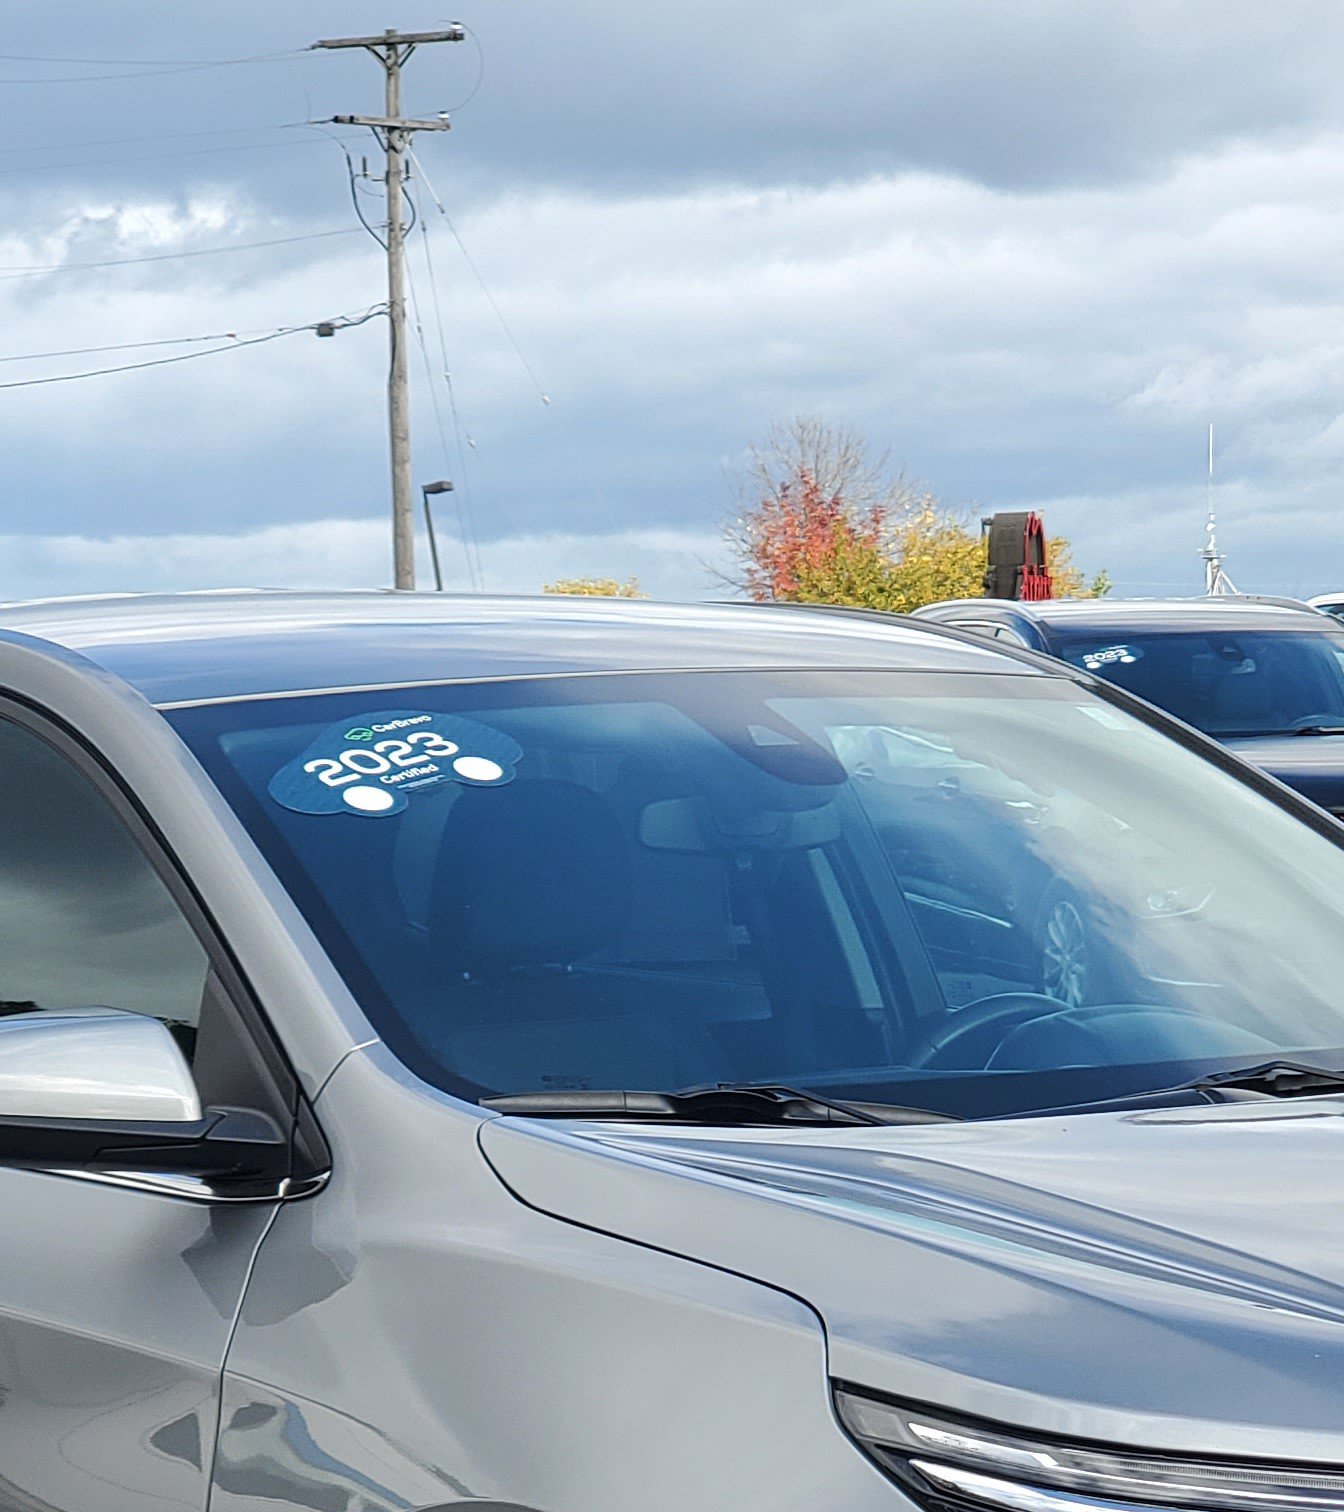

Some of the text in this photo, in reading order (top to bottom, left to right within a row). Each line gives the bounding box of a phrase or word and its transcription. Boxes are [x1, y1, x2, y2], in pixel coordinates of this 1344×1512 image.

[371, 715, 433, 732] CarBravo
[303, 731, 459, 787] 2023
[379, 763, 440, 784] Certified
